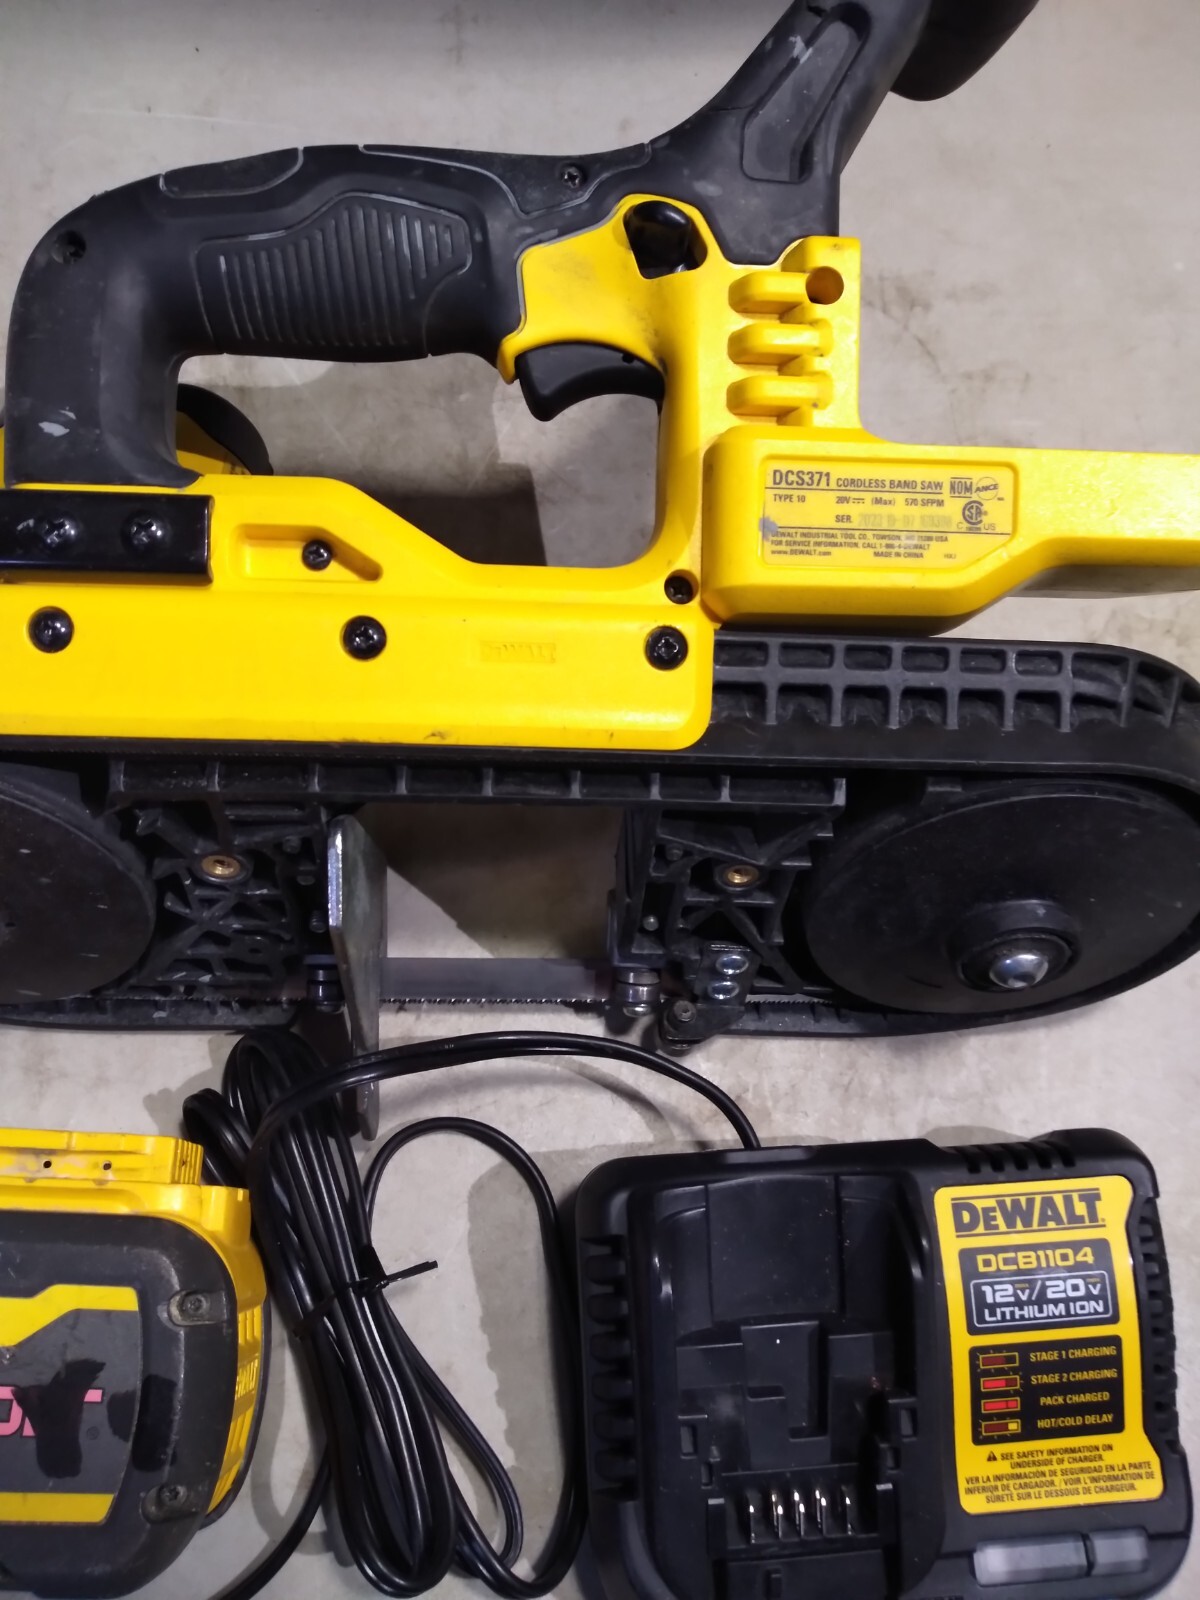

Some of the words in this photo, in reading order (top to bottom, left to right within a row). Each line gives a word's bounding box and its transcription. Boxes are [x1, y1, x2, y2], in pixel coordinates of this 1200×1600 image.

[772, 469, 830, 487] DCS371
[836, 478, 886, 488] CORDLESS
[889, 480, 917, 490] BAND
[920, 480, 943, 490] SAW
[950, 480, 973, 495] NOM
[974, 484, 999, 493] ANCE
[773, 494, 794, 503] TYPE
[797, 495, 806, 503] 10
[836, 496, 851, 504] 20V
[871, 496, 895, 506] (Max)
[905, 498, 918, 506] 570
[920, 498, 944, 507] SFPM
[951, 1192, 1102, 1233] DEWALT
[976, 1246, 1095, 1272] DCB1104
[984, 1303, 1065, 1321] LITHIUM
[1070, 1300, 1104, 1315] ION
[1030, 1351, 1059, 1362] STAGE
[1062, 1351, 1066, 1359] 1
[1068, 1346, 1117, 1359] CHARGING
[1030, 1374, 1060, 1384] STAGE
[1062, 1373, 1068, 1382] 2
[1069, 1369, 1118, 1381] CHARGING
[1040, 1395, 1064, 1406] PACK
[1066, 1392, 1110, 1404] CHARGED
[1037, 1416, 1082, 1429] HOT/COLD
[1085, 1414, 1113, 1424] DELAY
[1000, 1452, 1015, 1460] SEE
[1016, 1450, 1044, 1459] SAFETY
[1047, 1445, 1100, 1456] INFORMATION
[1102, 1444, 1113, 1452] ON
[1010, 1459, 1053, 1469] UNDERSIDE
[1056, 1457, 1065, 1465] OF
[1067, 1454, 1104, 1464] CHARGER.
[965, 1476, 980, 1485] VER
[982, 1475, 991, 1483] LA
[1048, 1469, 1058, 1477] DE
[1060, 1465, 1103, 1476] SEGURIDAD
[1105, 1464, 1115, 1472] EN
[1117, 1463, 1126, 1471] LA
[1128, 1461, 1152, 1470] PARTE
[964, 1485, 999, 1495] INFERIOR
[1001, 1484, 1011, 1492] DE
[1063, 1477, 1082, 1486] VOIR
[1083, 1472, 1143, 1484] L'INFORMATION
[1145, 1471, 1155, 1479] DE
[1017, 1492, 1032, 1501] SUR
[1034, 1491, 1042, 1499] LE
[1045, 1487, 1080, 1498] DESSOUS
[1082, 1486, 1092, 1495] DE
[1094, 1483, 1137, 1494] CHARGEUR.
